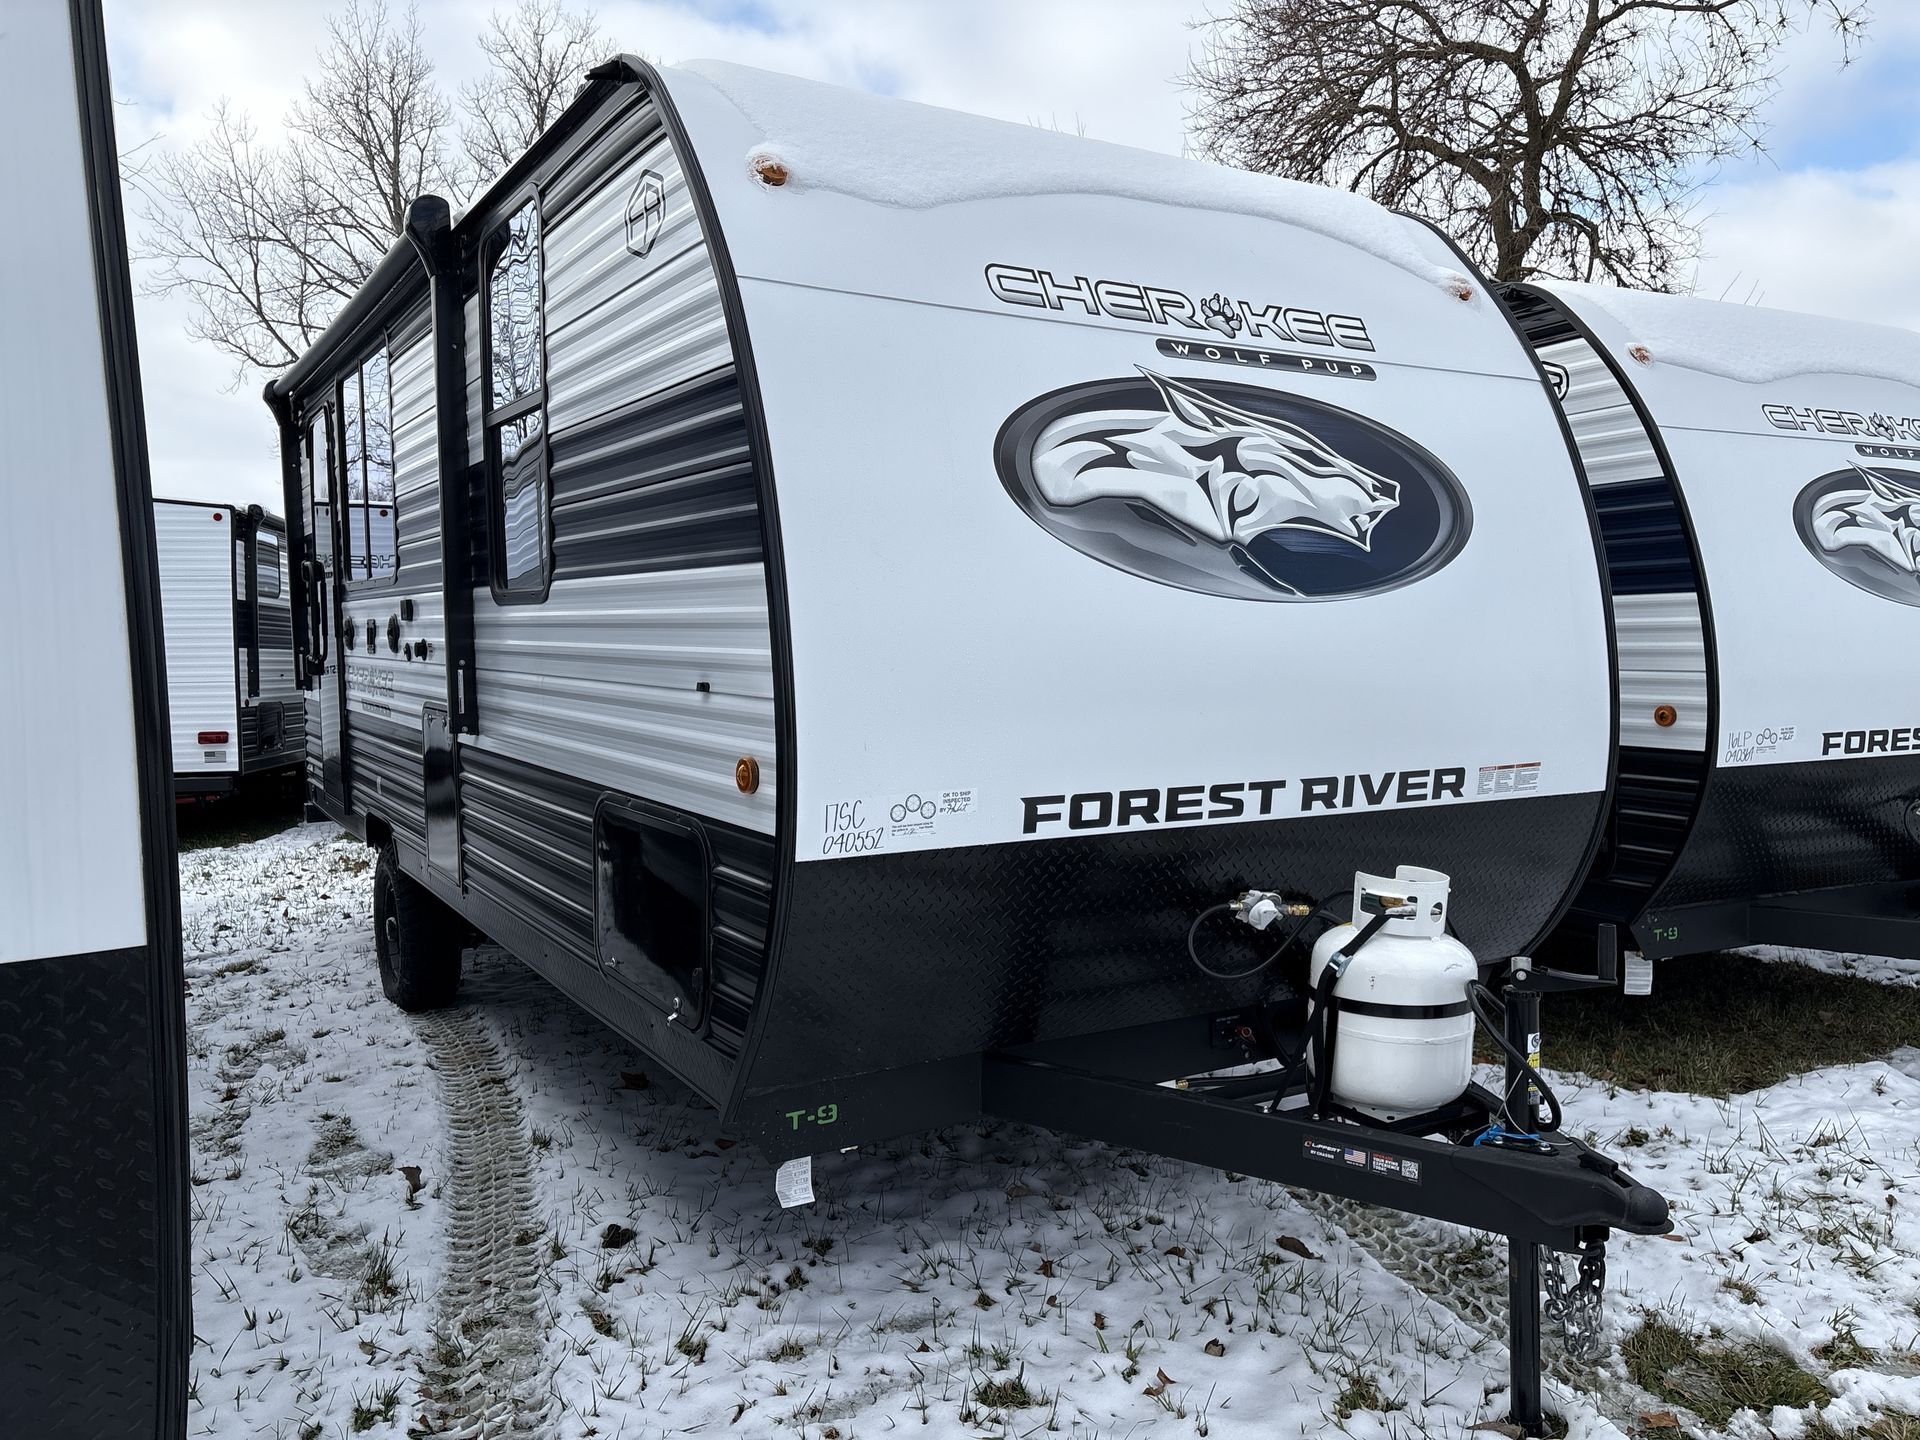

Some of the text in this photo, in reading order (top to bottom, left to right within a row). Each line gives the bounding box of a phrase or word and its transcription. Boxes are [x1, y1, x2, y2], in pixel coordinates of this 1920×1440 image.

[1170, 342, 1363, 377] WOLF PUP
[1862, 446, 1915, 458] WOLF
[824, 800, 866, 834] 17SC
[1019, 780, 1287, 834] FOREST
[1299, 766, 1466, 811] RIVER
[822, 826, 885, 855] 040552
